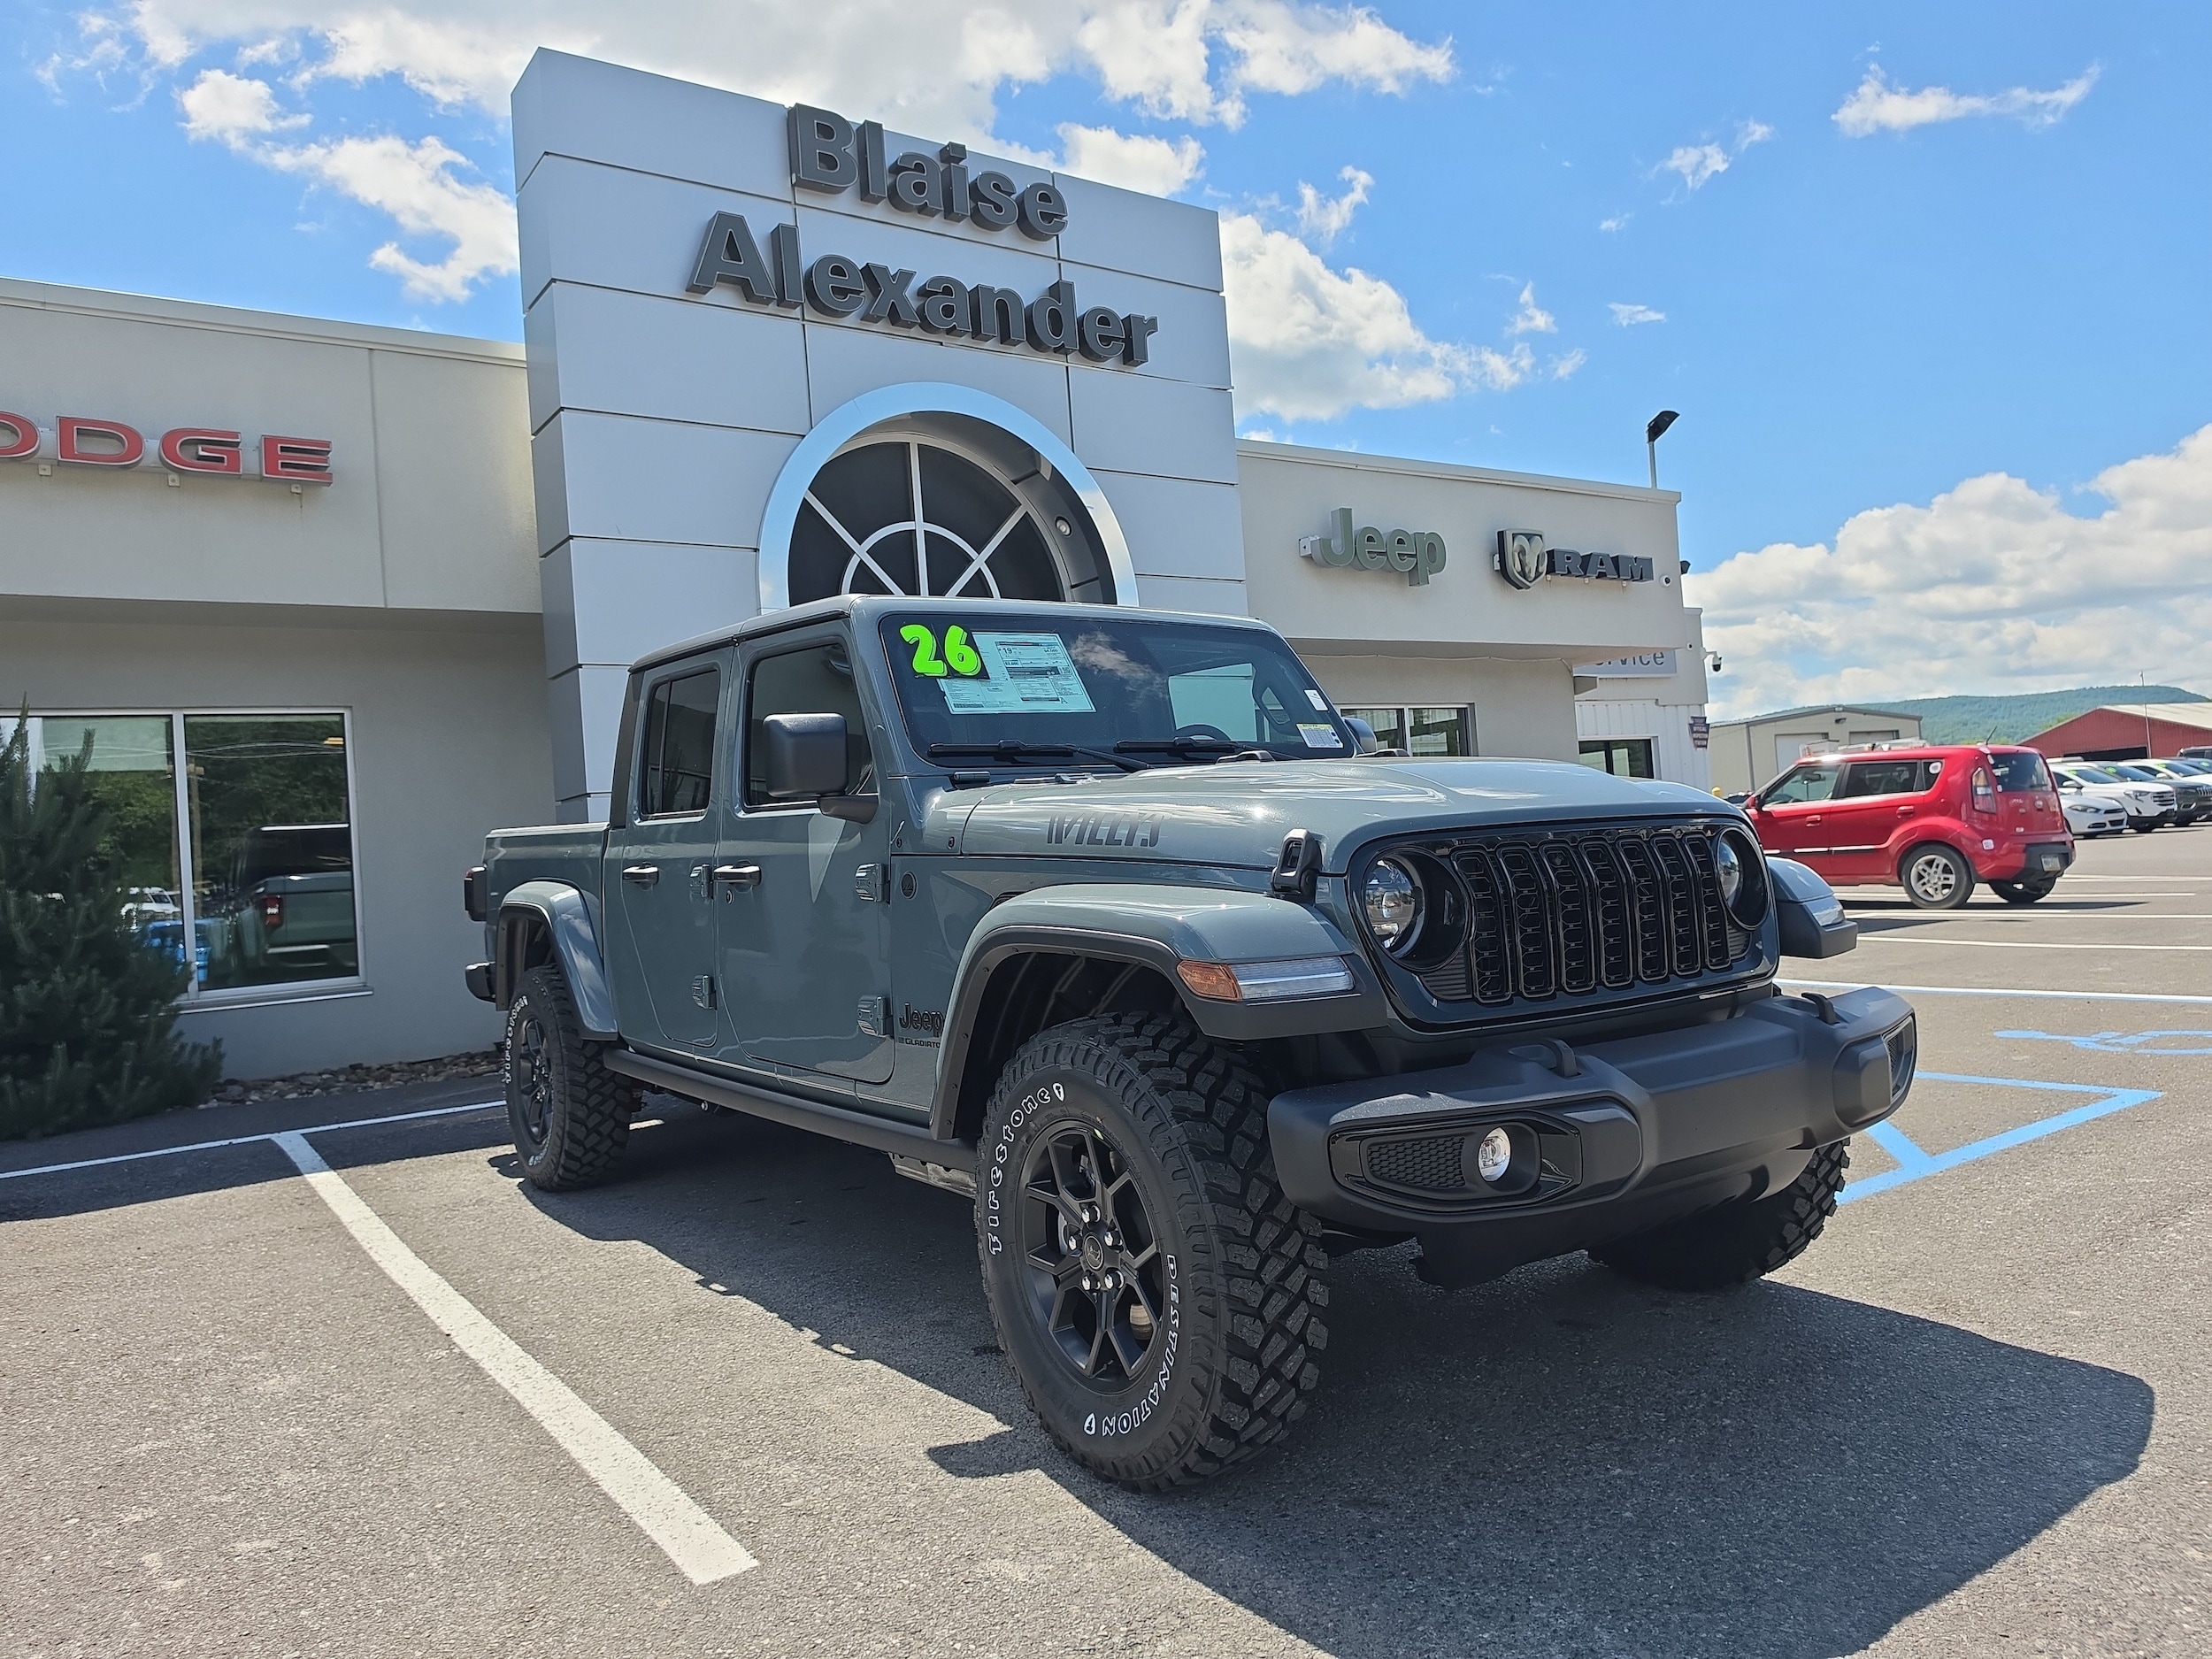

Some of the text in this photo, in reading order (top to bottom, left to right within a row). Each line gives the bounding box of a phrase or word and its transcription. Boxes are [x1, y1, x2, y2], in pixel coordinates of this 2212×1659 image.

[788, 103, 1068, 242] Blaise
[686, 211, 1158, 367] Alexander
[1310, 507, 1447, 587] Jeep
[1546, 548, 1654, 581] RAM
[900, 623, 982, 676] 26
[1047, 811, 1168, 847] WILLYS
[899, 1002, 945, 1038] Jeep
[905, 1038, 941, 1048] GLADIATO
[987, 1086, 1052, 1255] Firestone
[1101, 1253, 1181, 1438] DESTINATION
